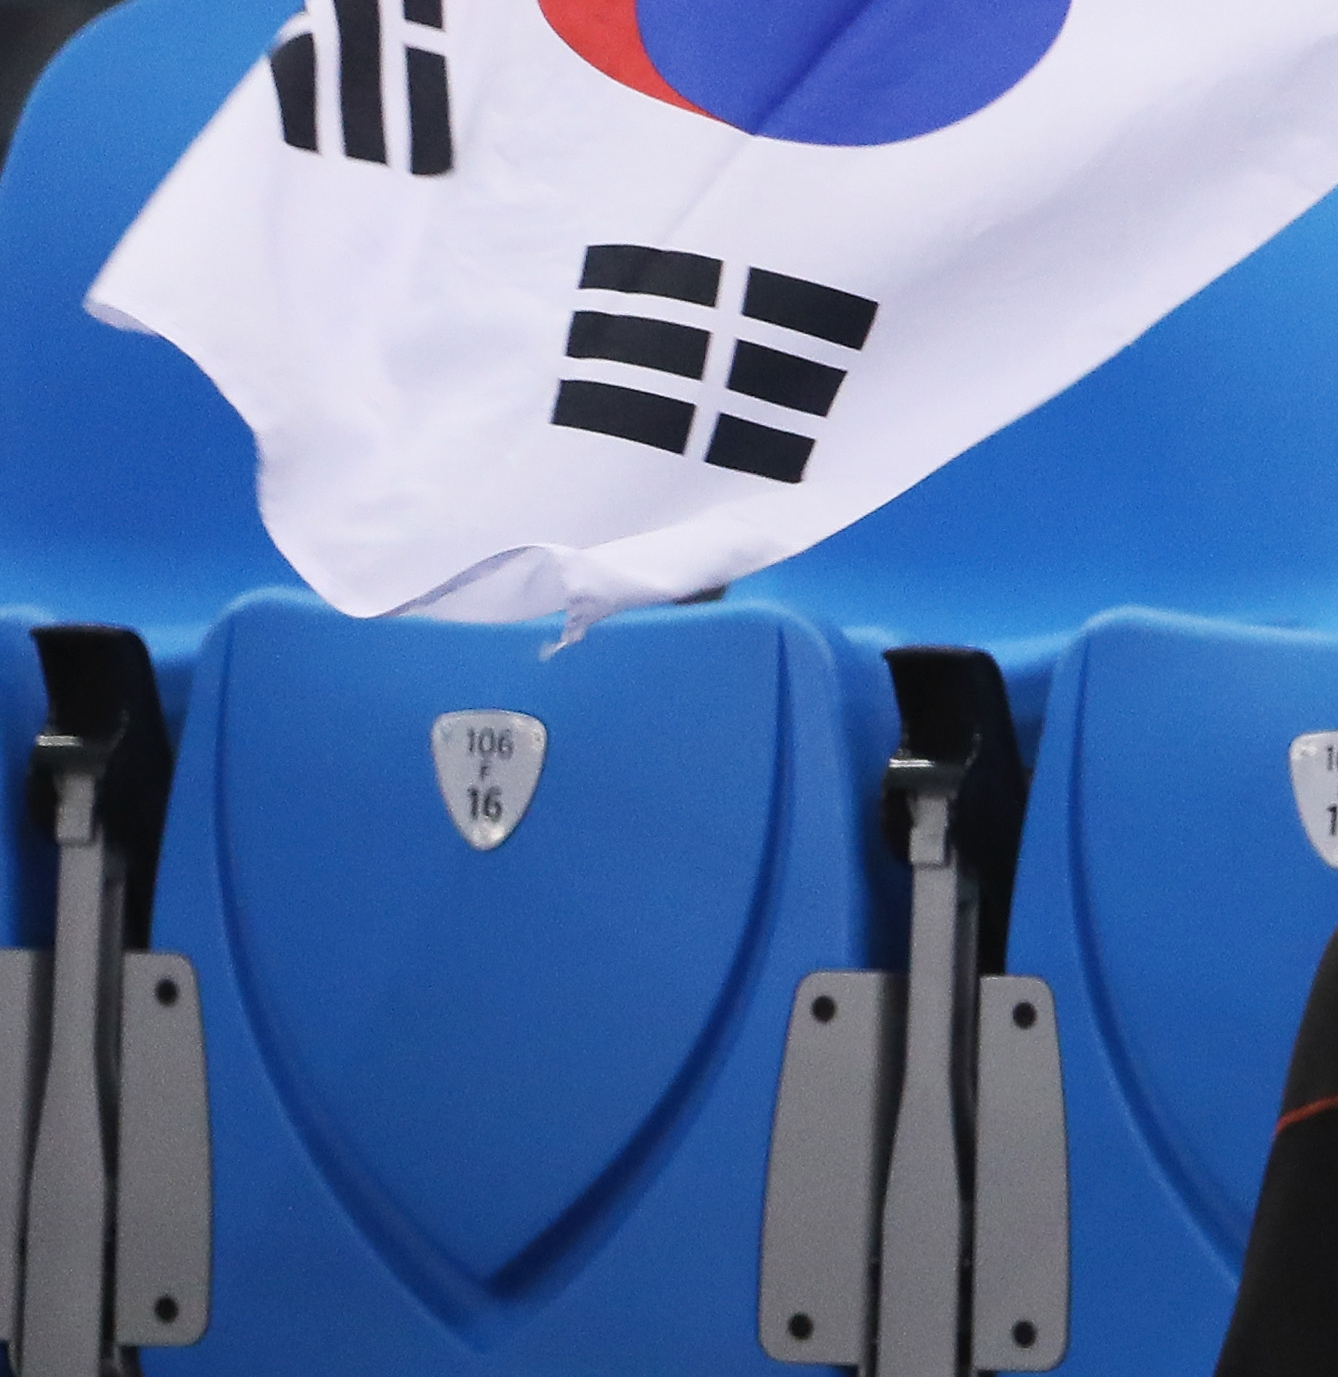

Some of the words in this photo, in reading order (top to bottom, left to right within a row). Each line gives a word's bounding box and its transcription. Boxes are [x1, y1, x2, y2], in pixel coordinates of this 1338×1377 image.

[467, 726, 514, 760] 106
[479, 765, 490, 781] F
[467, 785, 503, 822] 16
